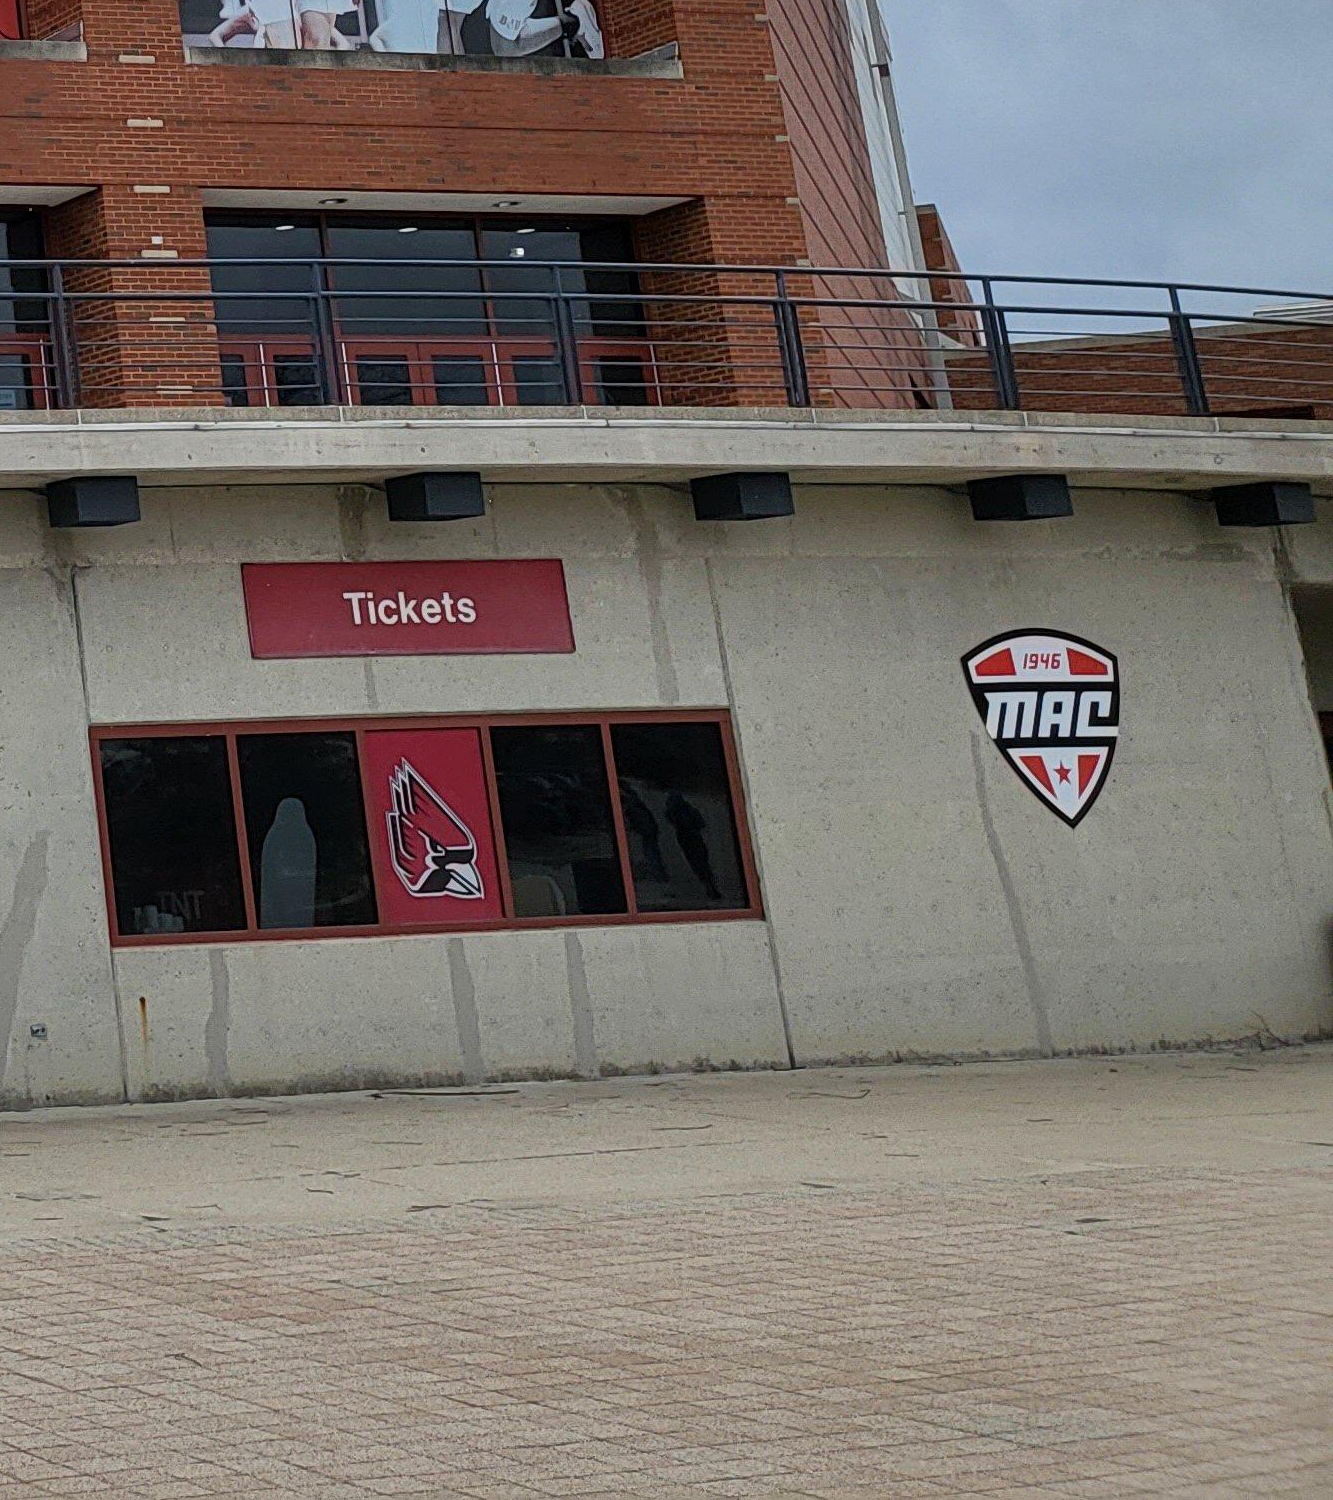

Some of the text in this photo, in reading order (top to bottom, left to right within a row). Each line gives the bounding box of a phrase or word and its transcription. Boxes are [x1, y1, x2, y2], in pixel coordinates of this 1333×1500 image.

[343, 590, 477, 626] Tickets
[1022, 652, 1062, 670] 1946
[984, 690, 1119, 740] MAC
